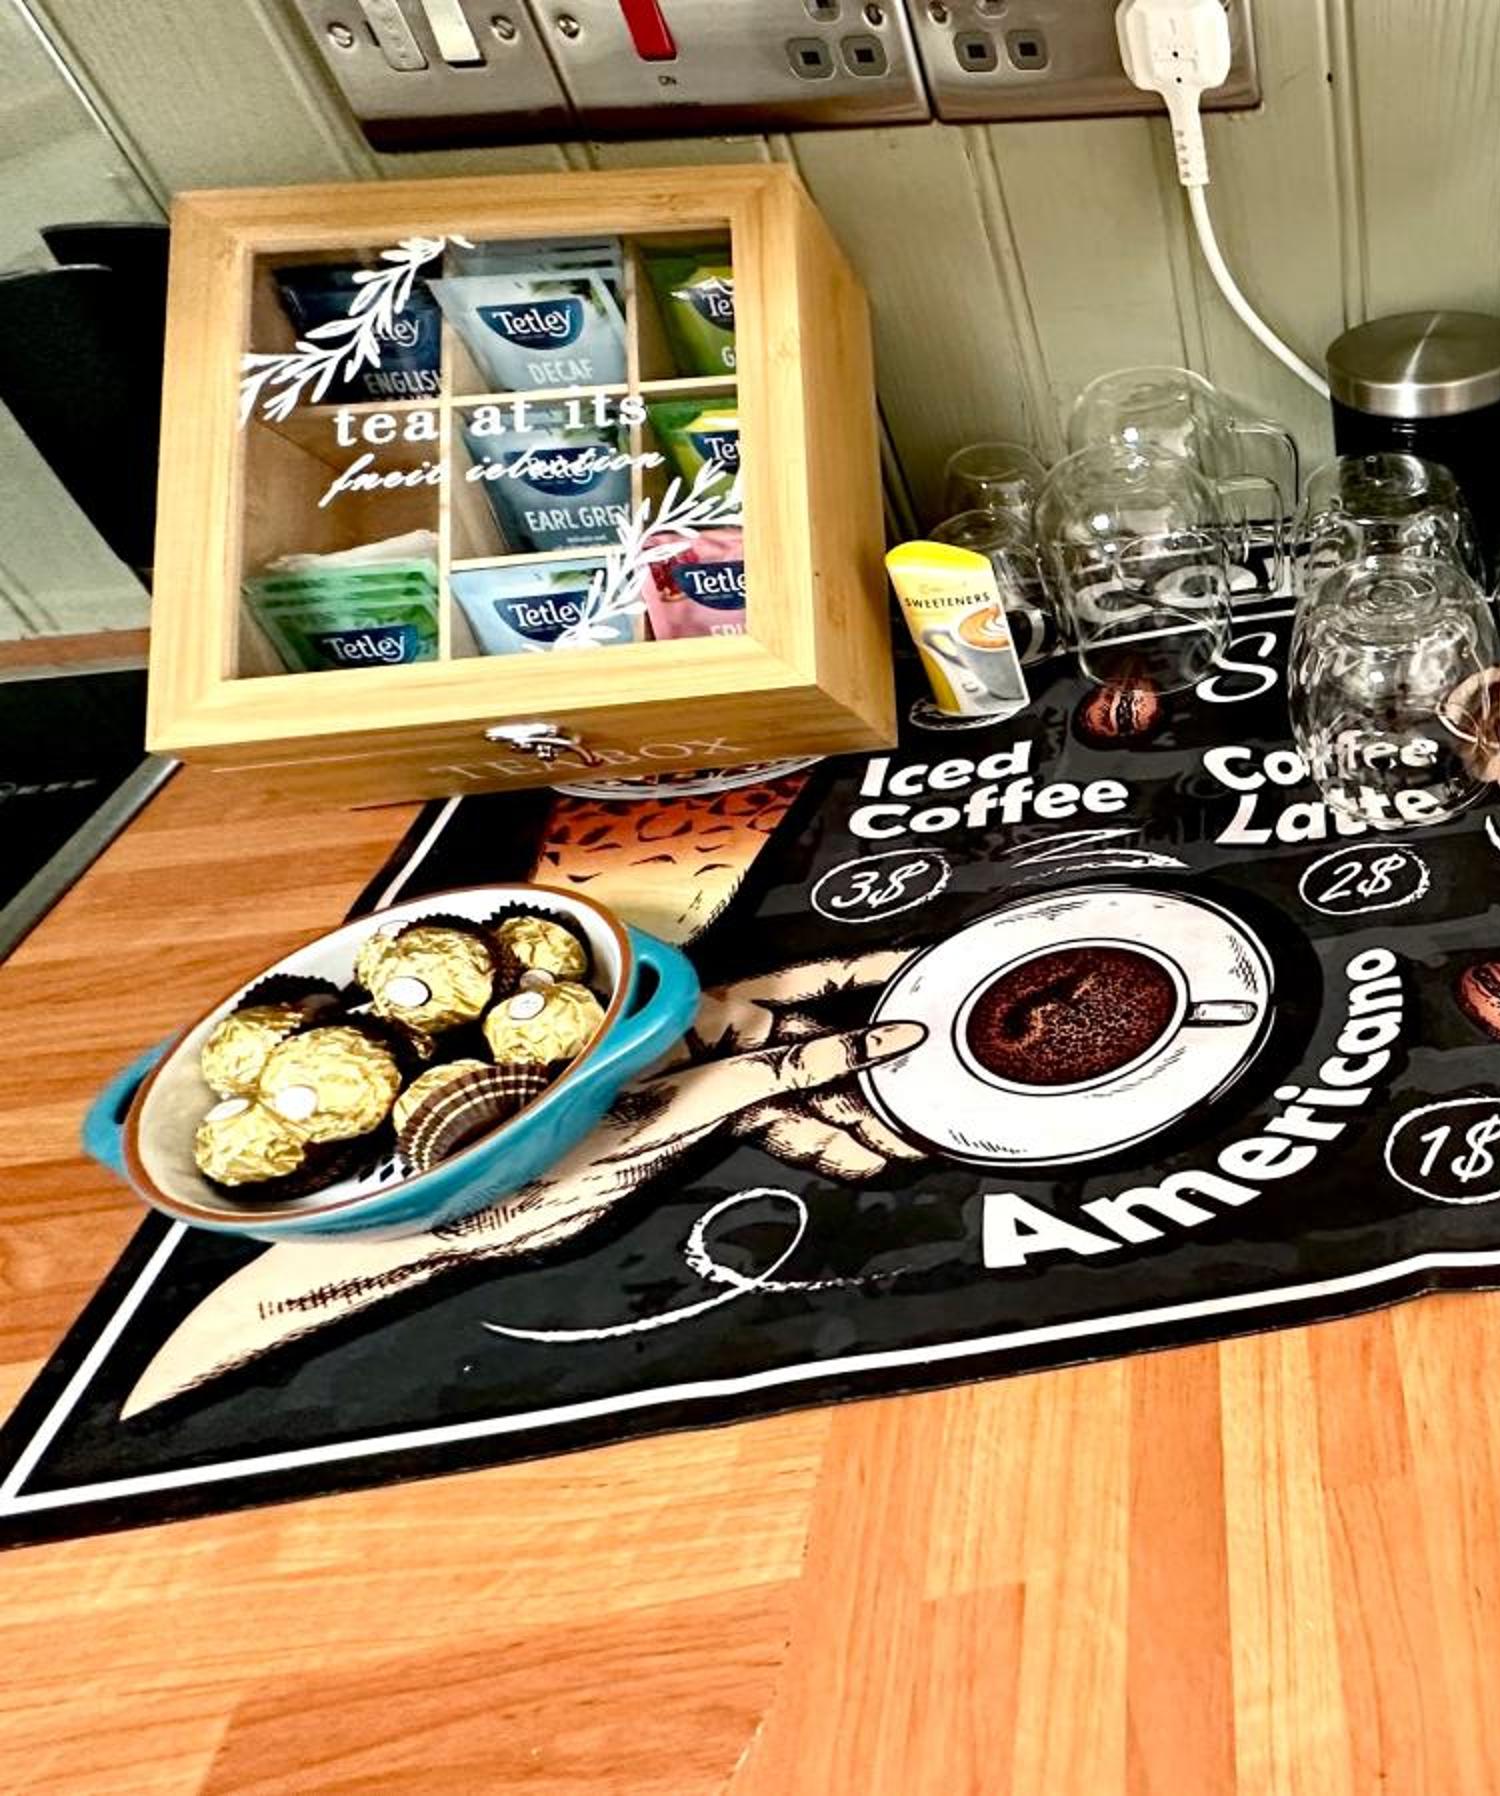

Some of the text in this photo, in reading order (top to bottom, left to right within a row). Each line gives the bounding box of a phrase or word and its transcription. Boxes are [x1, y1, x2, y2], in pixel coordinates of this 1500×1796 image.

[491, 303, 572, 338] Tetley
[528, 358, 593, 385] DECAF
[332, 386, 648, 447] tea at its
[524, 508, 579, 532] EARL
[684, 567, 746, 598] Tetle
[904, 591, 991, 609] SWEETENERS
[507, 599, 586, 630] Tetley
[322, 630, 406, 663] Tetley
[859, 740, 1033, 797] Iced
[848, 776, 1129, 839] Coffee
[831, 859, 930, 908] 3$
[1317, 853, 1407, 903] 2$
[983, 947, 1403, 1269] Americano
